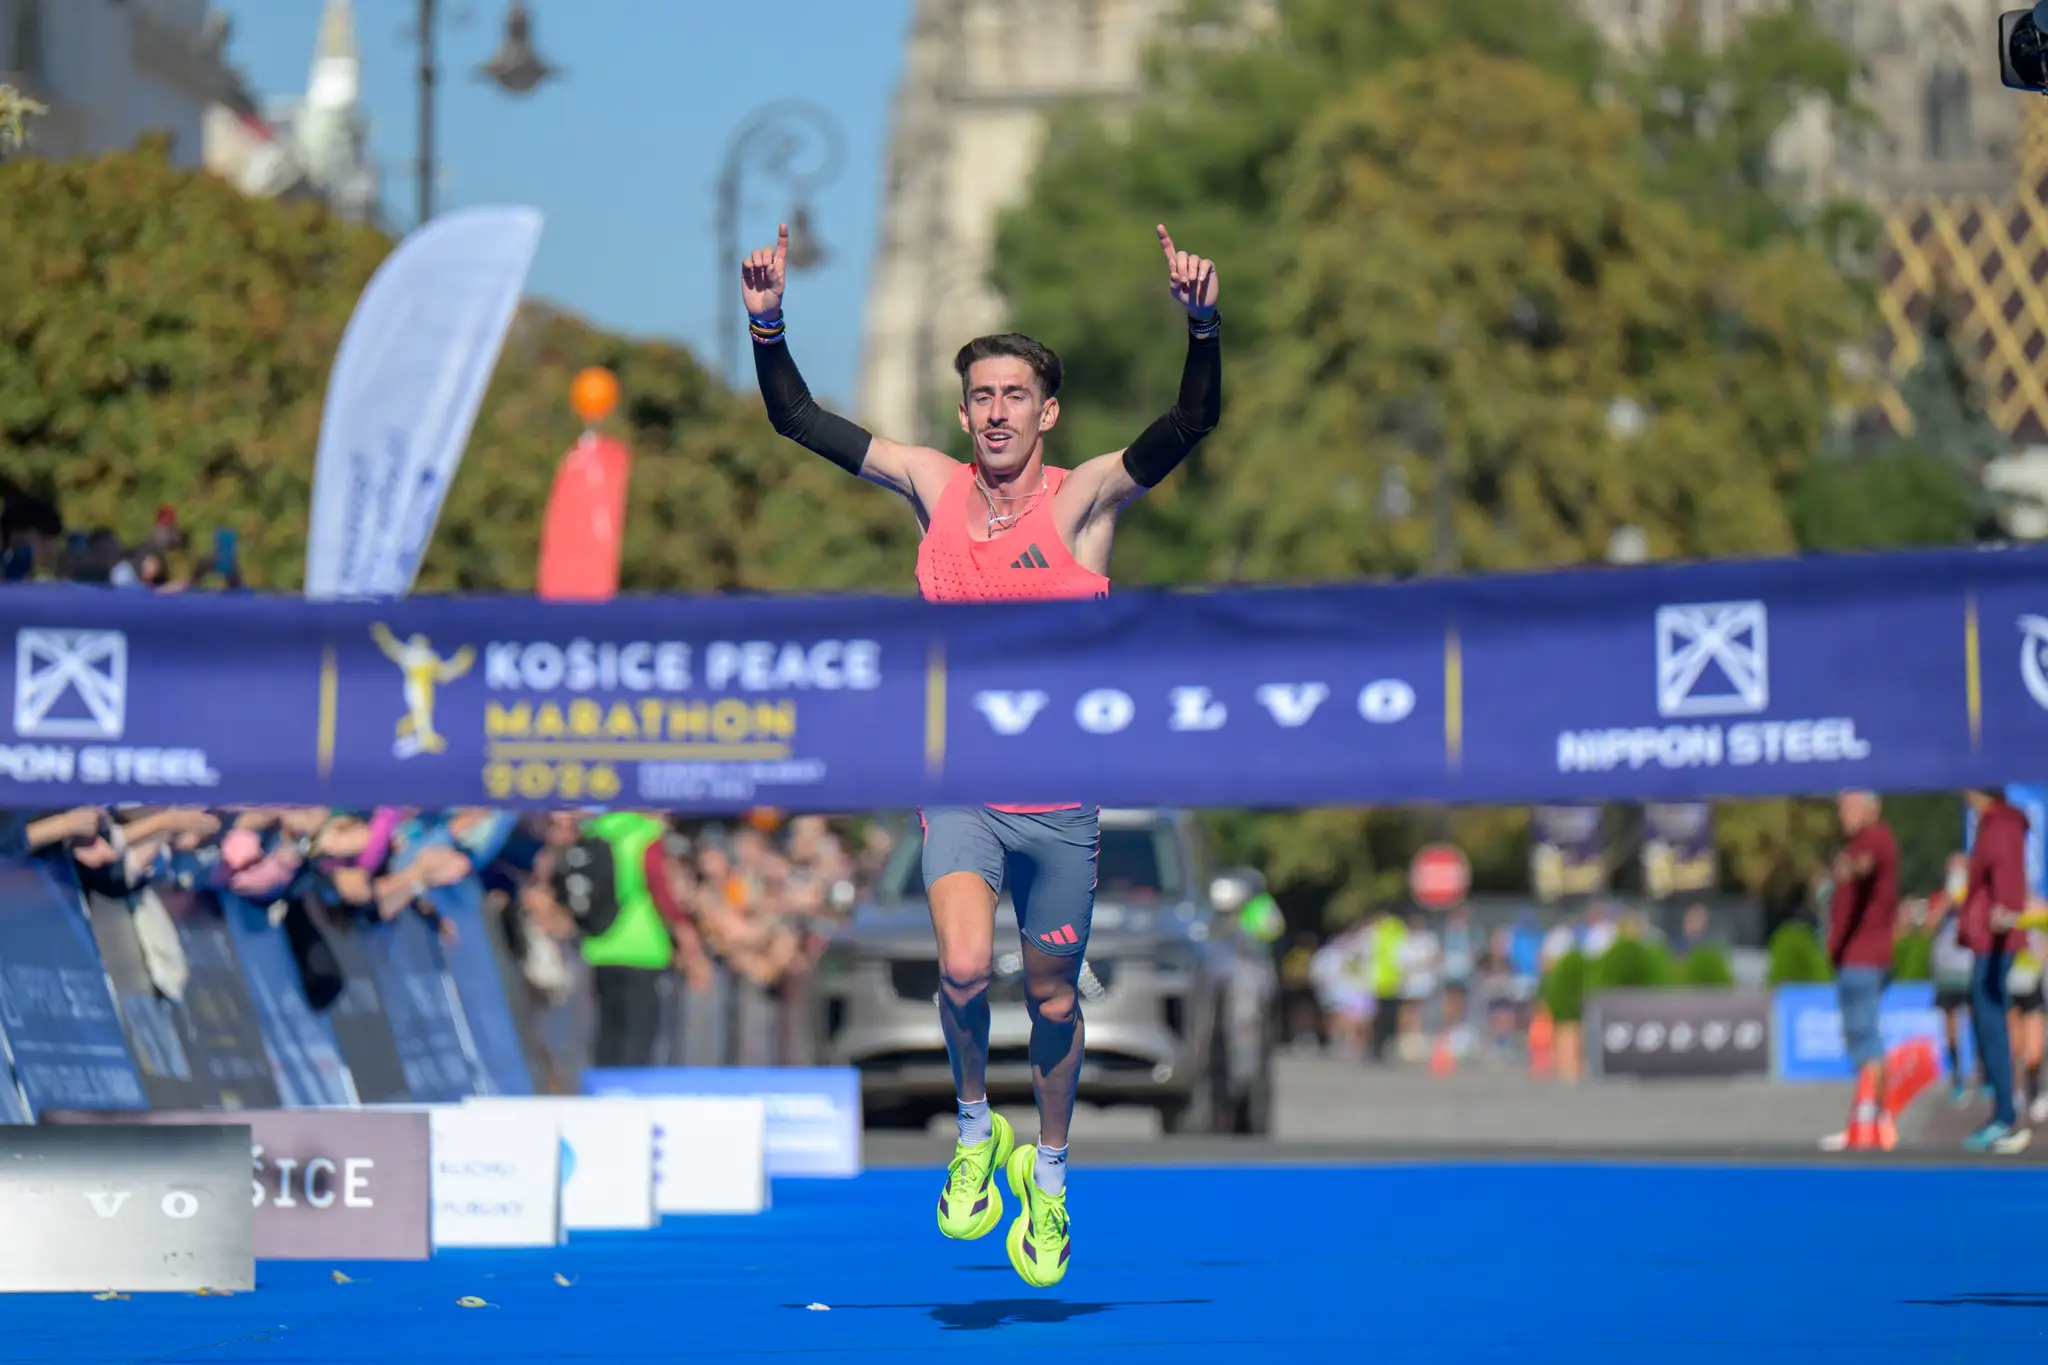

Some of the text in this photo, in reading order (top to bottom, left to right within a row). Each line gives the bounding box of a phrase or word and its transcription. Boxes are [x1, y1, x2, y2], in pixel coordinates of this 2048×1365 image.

[706, 639, 881, 691] PEACE
[484, 698, 797, 740] MARATHON
[972, 678, 1416, 736] VOLVO
[78, 747, 221, 787] STEEL
[1557, 717, 1870, 773] NIPPON STEEL
